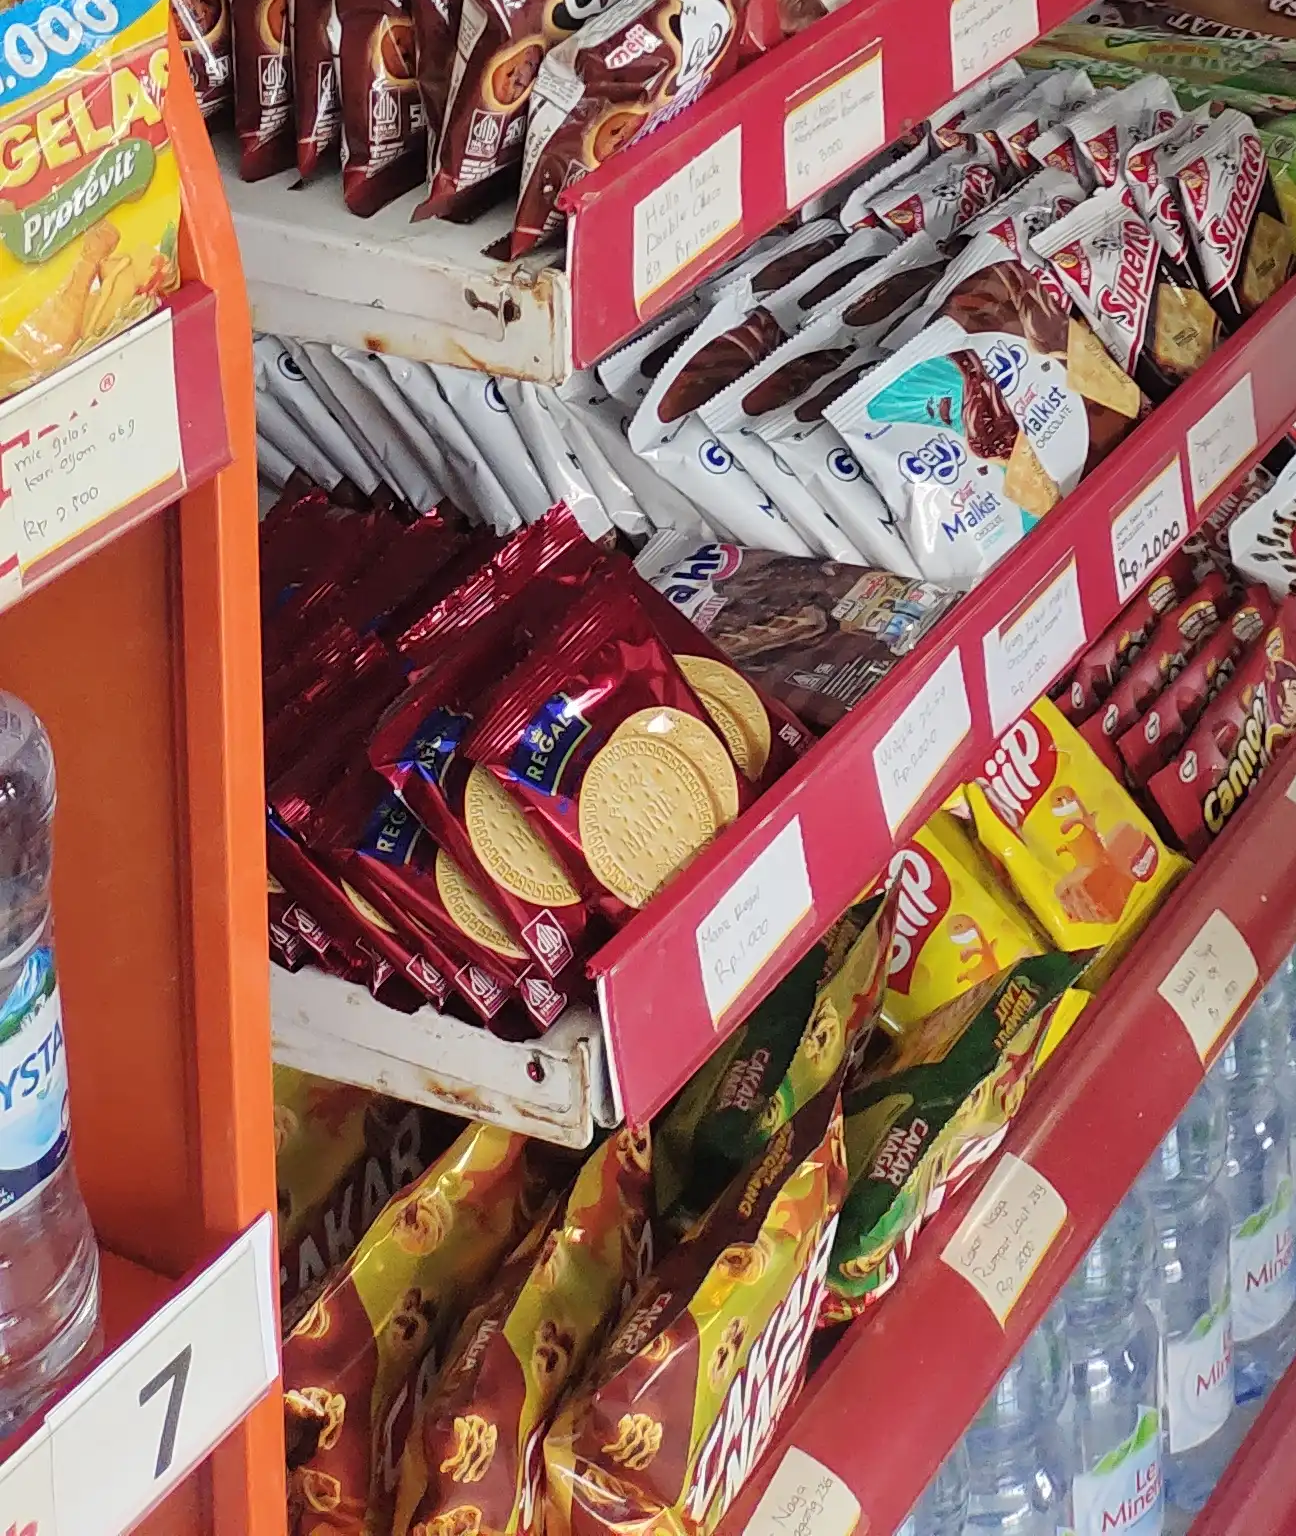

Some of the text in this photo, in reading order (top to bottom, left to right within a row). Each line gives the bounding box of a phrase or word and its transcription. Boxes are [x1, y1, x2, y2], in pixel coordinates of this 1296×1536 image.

[23, 149, 137, 256] Protevit
[645, 191, 680, 229] Hello
[899, 433, 967, 485] Gery
[940, 490, 1002, 543] Malkist
[869, 1126, 907, 1180] NAGA
[889, 1116, 929, 1188] CAKAR
[137, 1342, 193, 1480] 7
[772, 1483, 809, 1528] Naga
